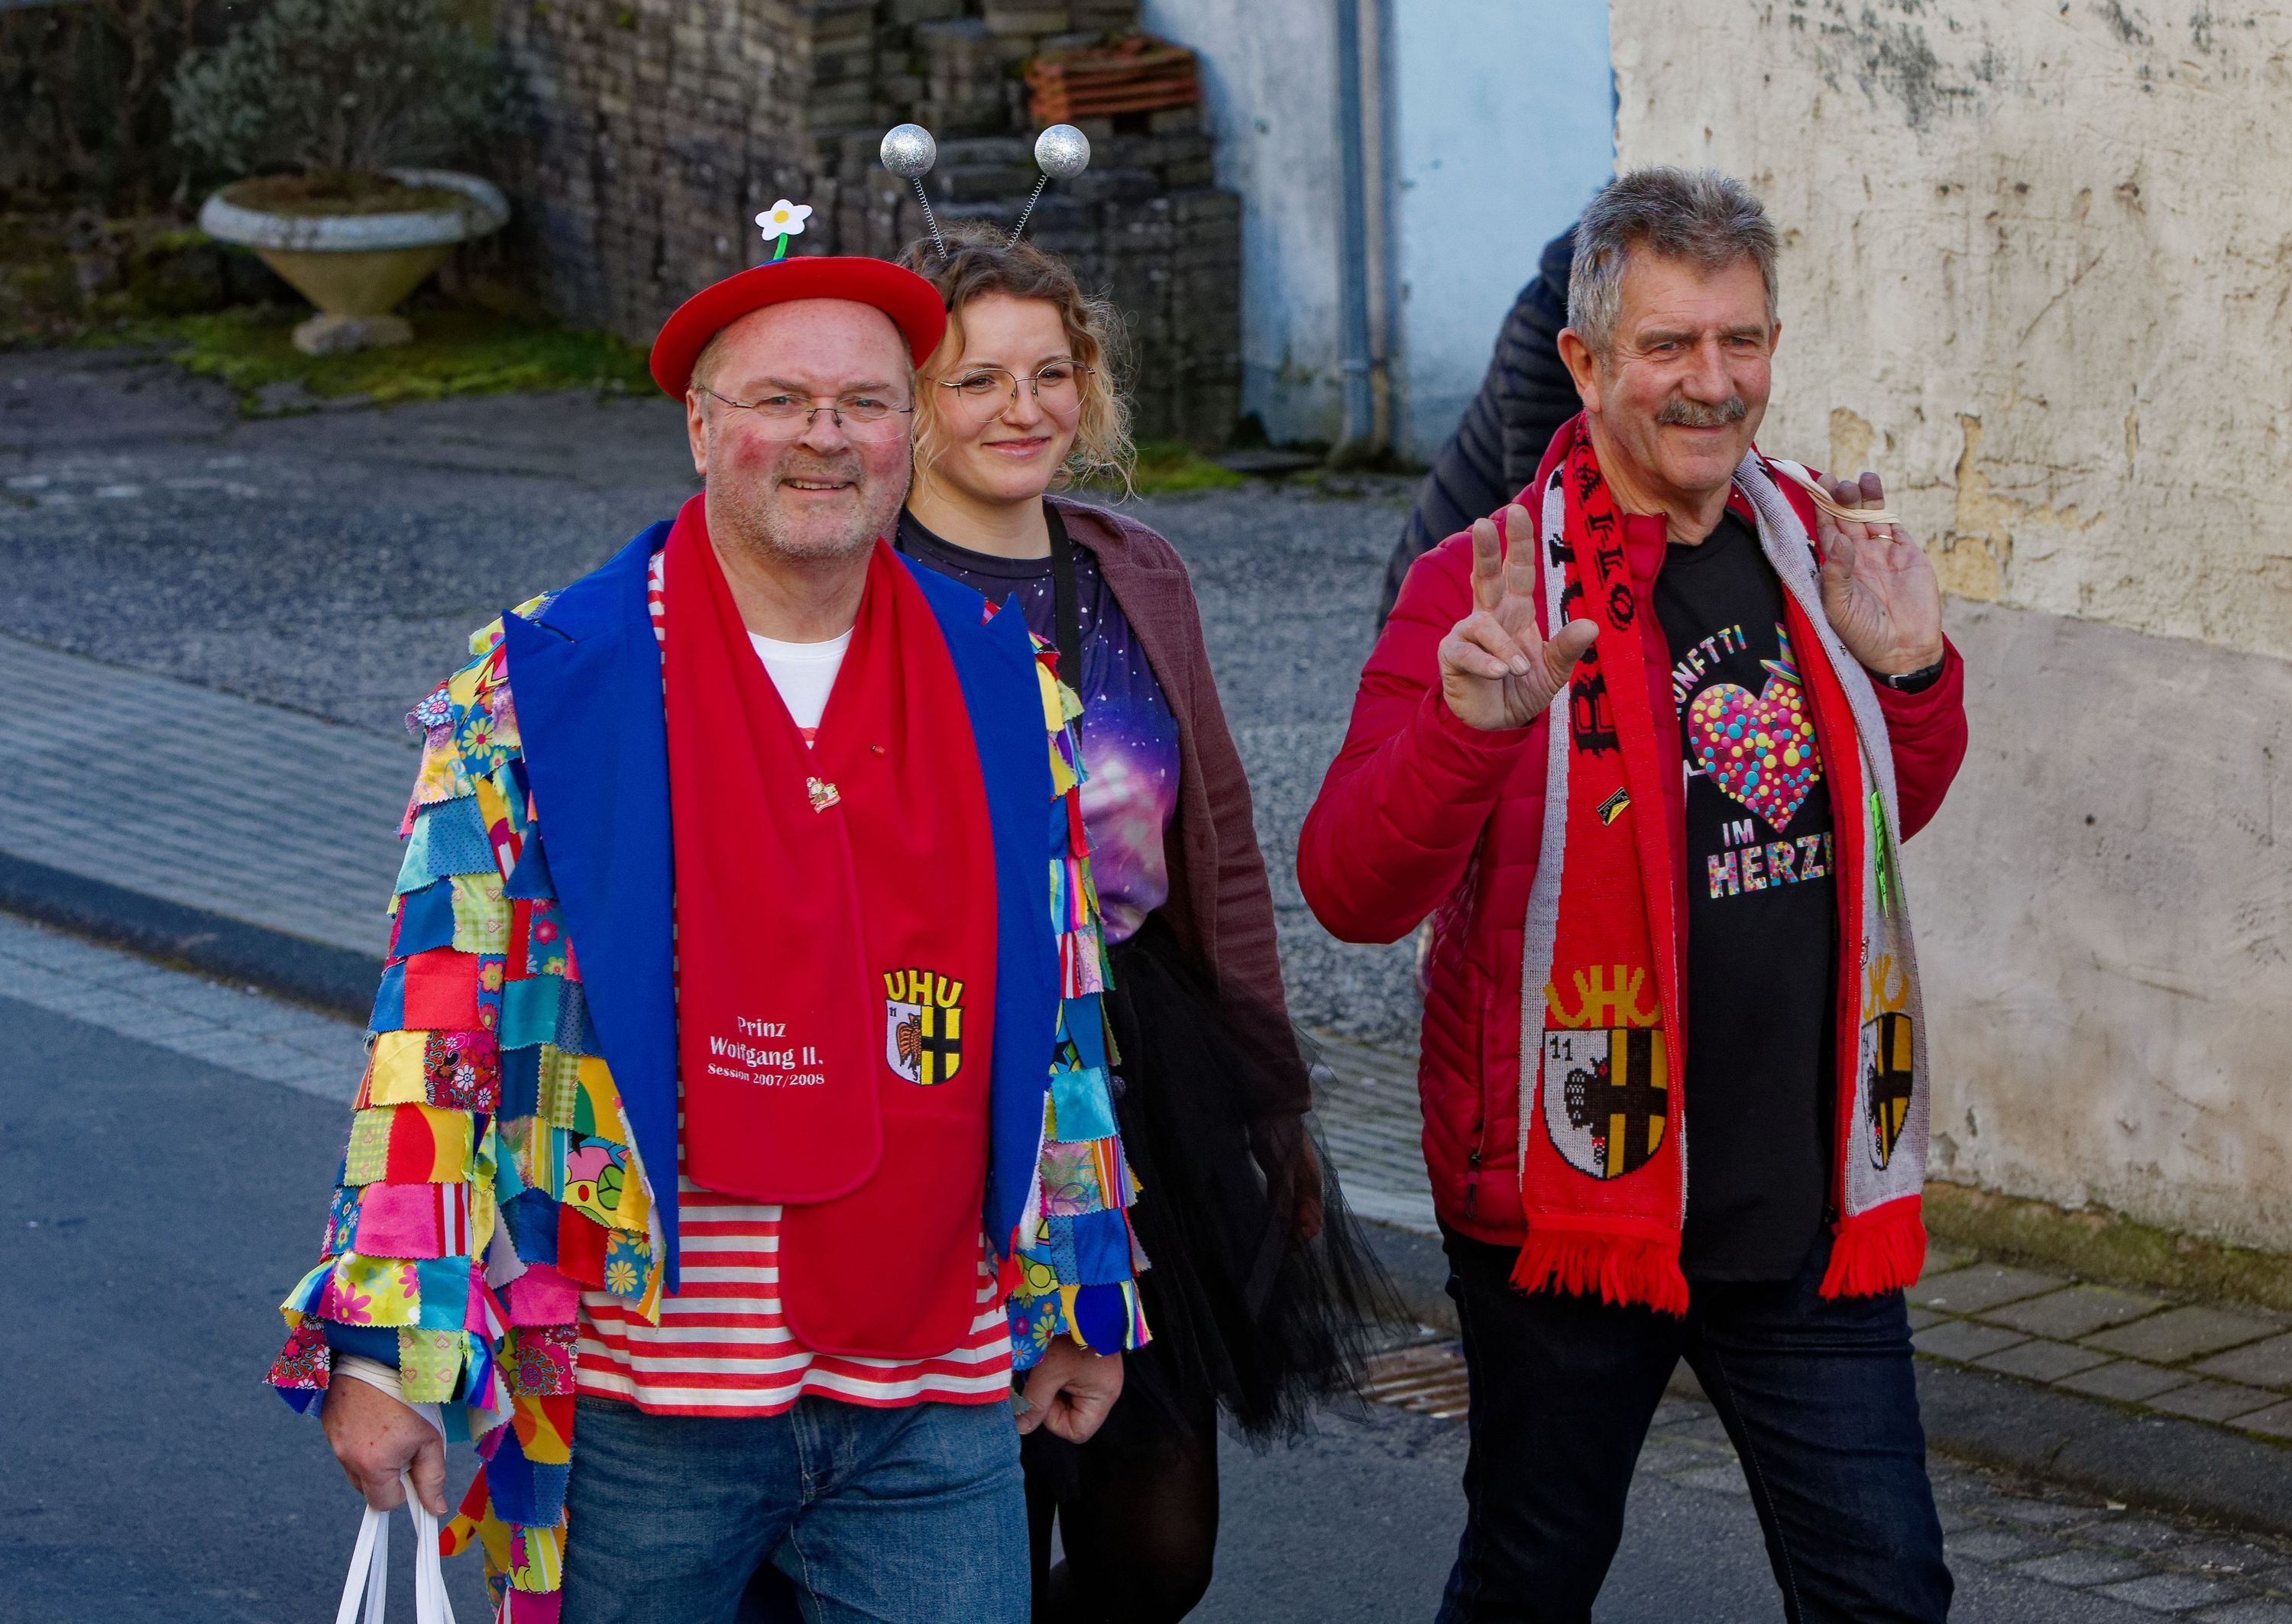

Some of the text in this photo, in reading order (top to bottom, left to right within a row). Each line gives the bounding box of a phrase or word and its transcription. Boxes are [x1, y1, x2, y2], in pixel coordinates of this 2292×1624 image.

[1672, 624, 1747, 721] ONFTTI
[1722, 818, 1755, 847] IM
[883, 969, 964, 1009] UHU
[1543, 965, 1662, 1027] UHU
[736, 1016, 787, 1037] Prinz
[709, 1035, 796, 1070] Wolfgang
[1549, 1035, 1573, 1062] 11
[707, 1063, 826, 1089] Session 2007/2008
